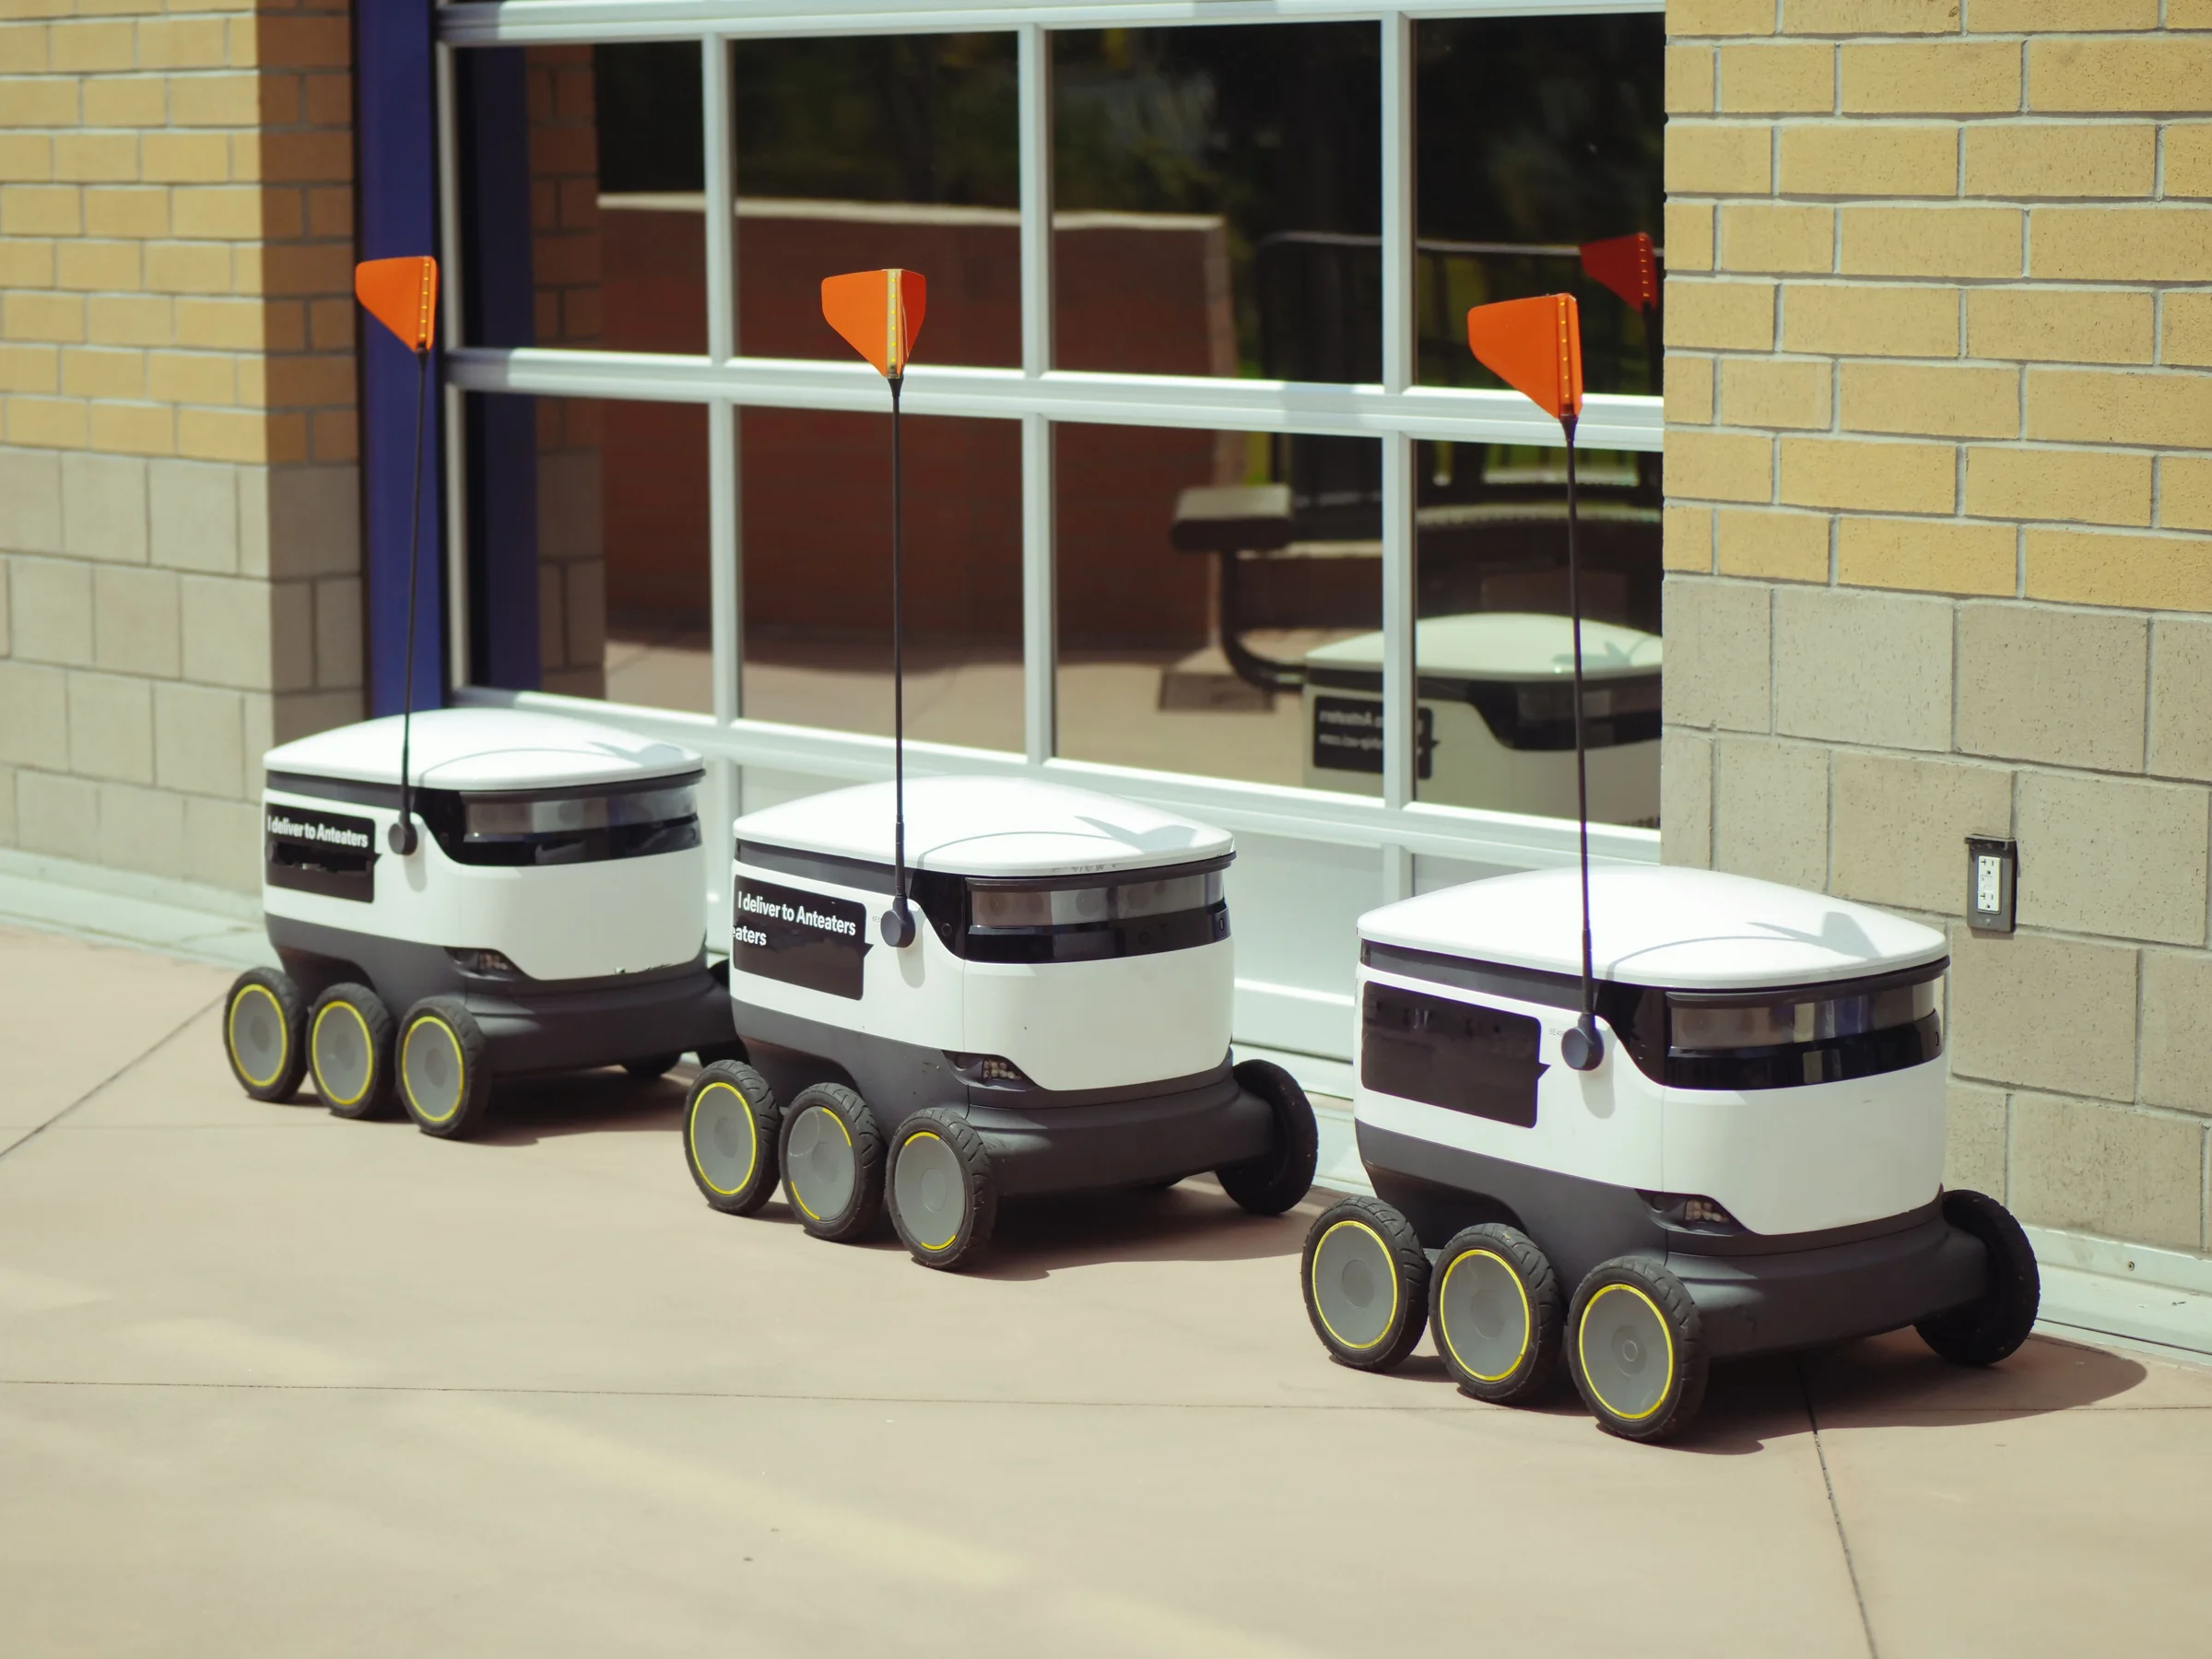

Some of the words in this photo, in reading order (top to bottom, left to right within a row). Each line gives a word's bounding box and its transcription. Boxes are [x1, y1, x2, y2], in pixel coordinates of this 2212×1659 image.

[267, 816, 272, 832] I
[272, 817, 303, 836] deliver
[305, 823, 316, 840] to
[317, 823, 369, 848] Anteaters
[738, 890, 742, 909] I
[743, 893, 781, 918] deliver
[782, 903, 794, 922] to
[796, 906, 856, 936] Anteaters
